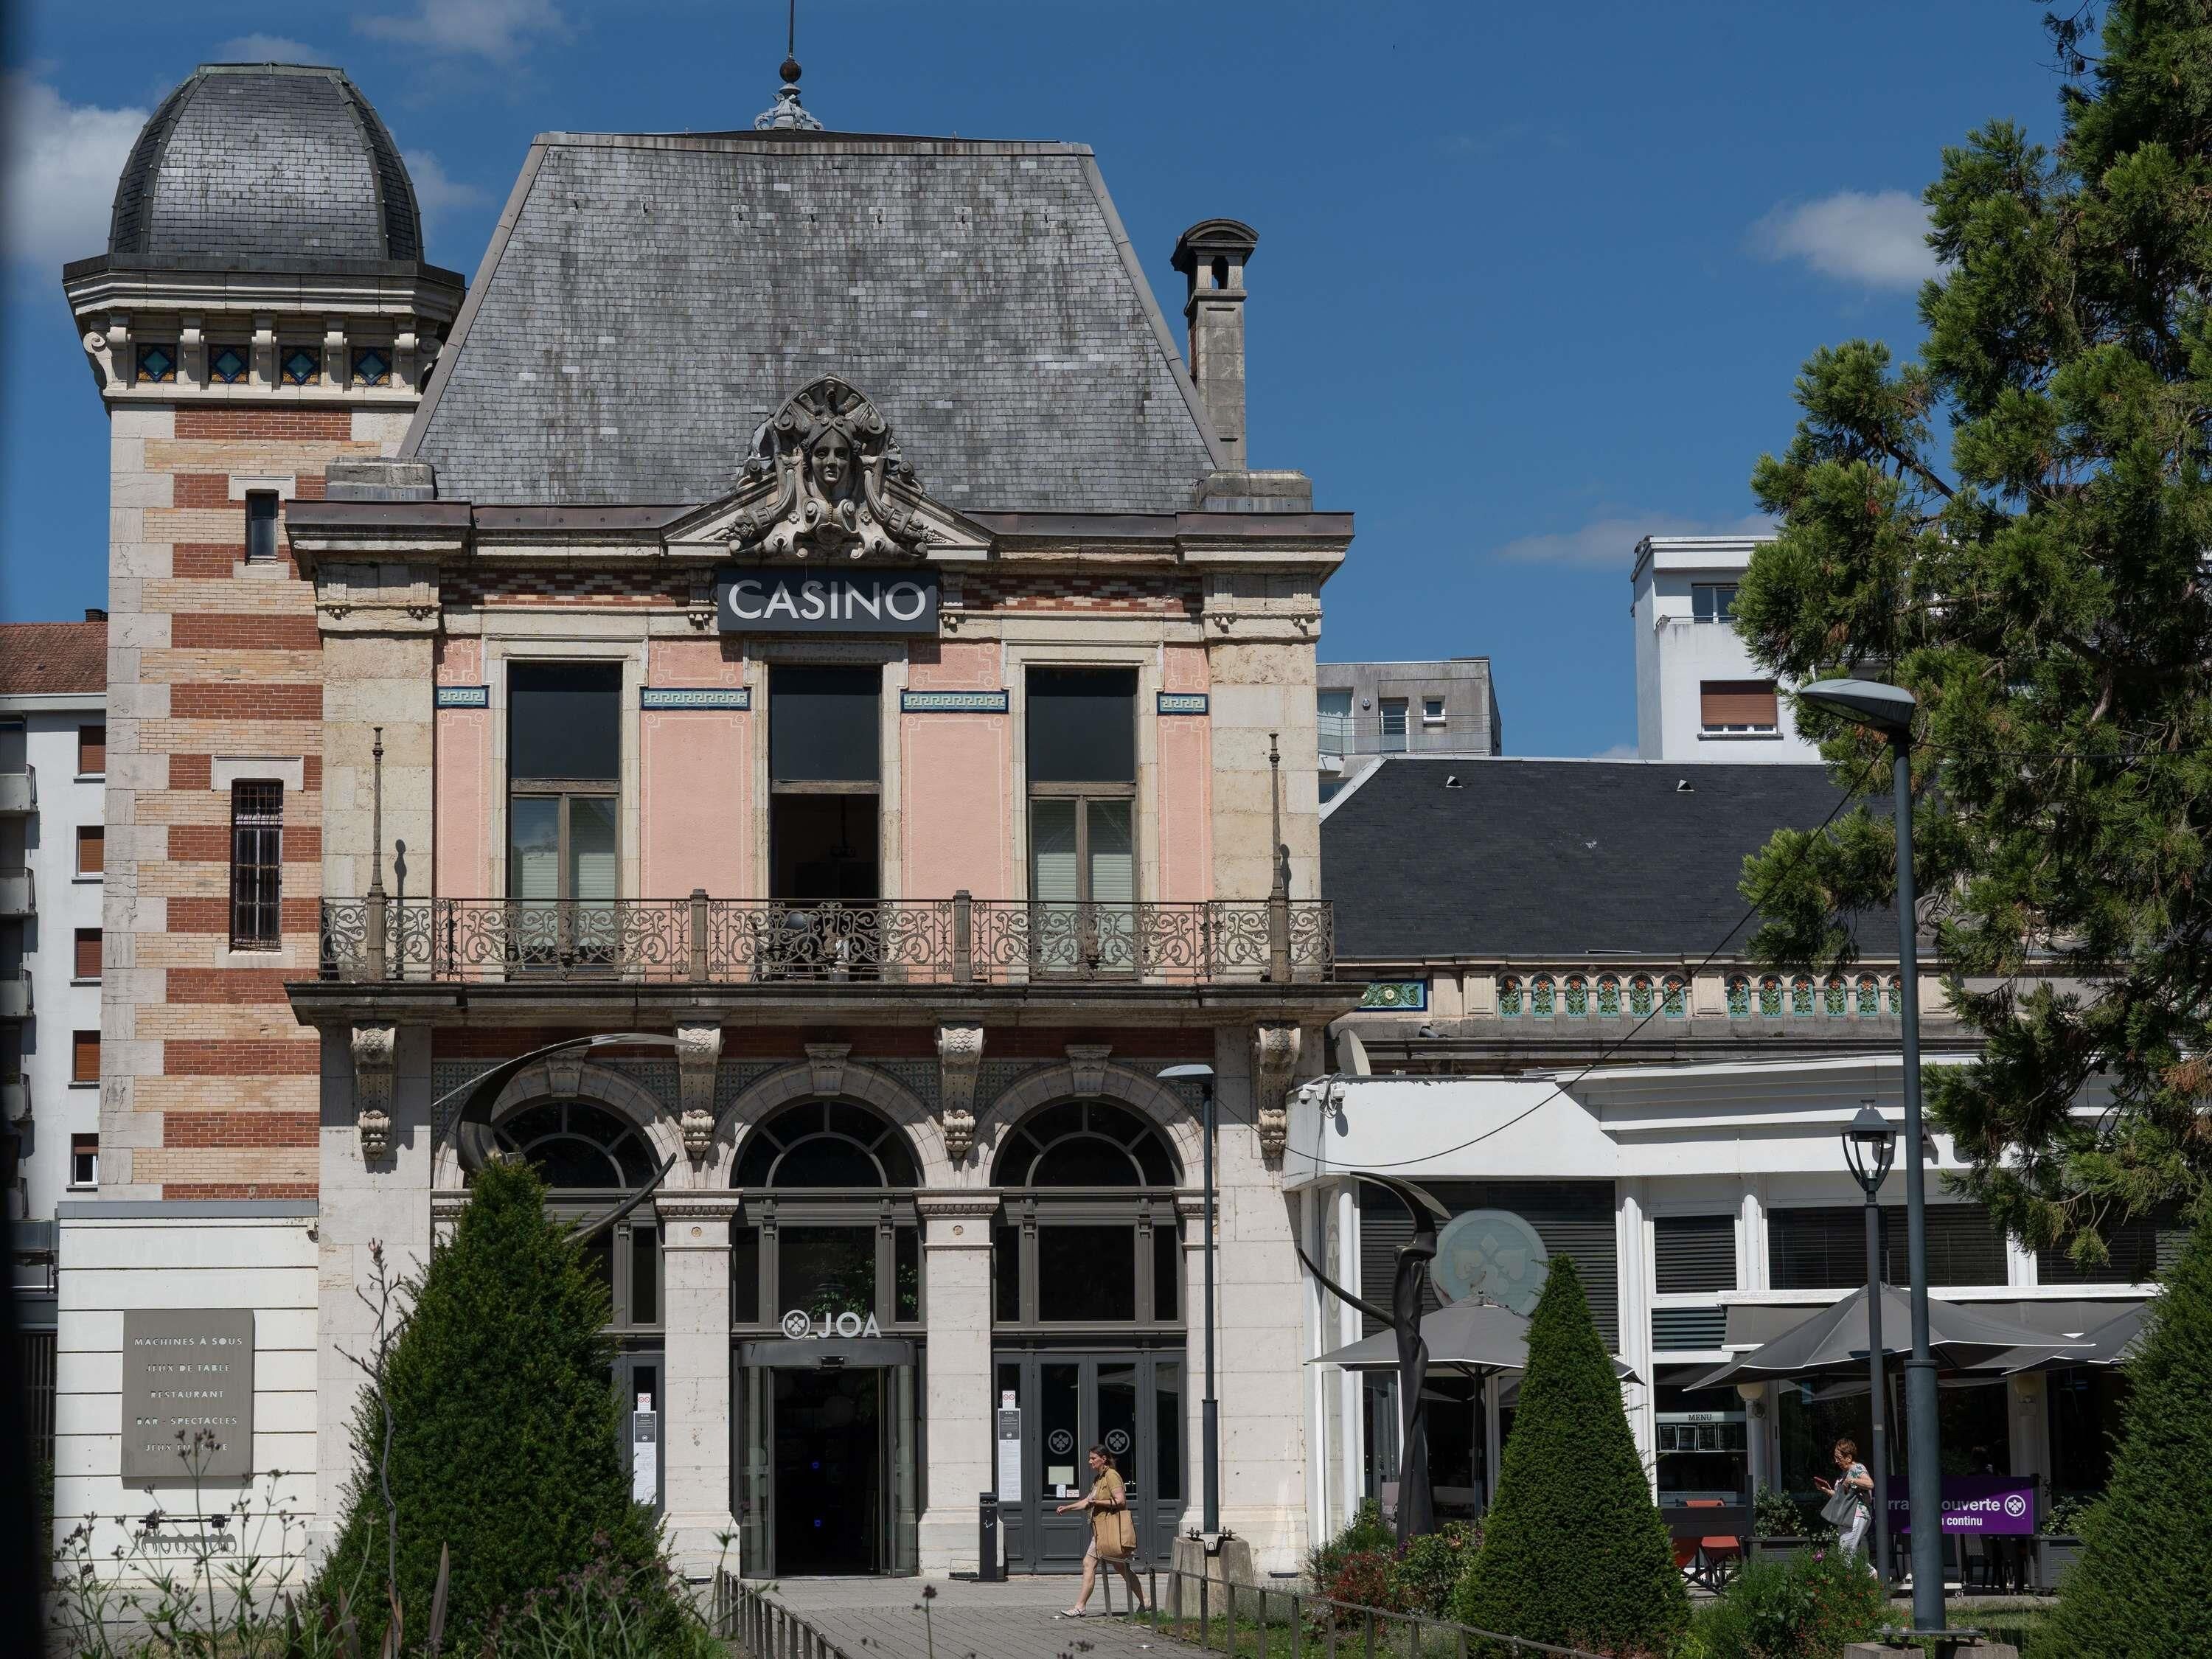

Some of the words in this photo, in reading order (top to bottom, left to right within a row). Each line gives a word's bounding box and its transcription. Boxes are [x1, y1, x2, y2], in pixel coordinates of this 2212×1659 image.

[728, 580, 926, 620] CASINO
[817, 1311, 882, 1338] JOA
[134, 1338, 195, 1346] MACHINES
[200, 1335, 207, 1345] À
[212, 1338, 243, 1346] SOUS
[146, 1364, 173, 1372] JEUX
[179, 1364, 193, 1372] DE
[198, 1364, 231, 1372] TABLE
[1941, 1498, 2000, 1511] ouverte
[1947, 1515, 1983, 1526] continu
